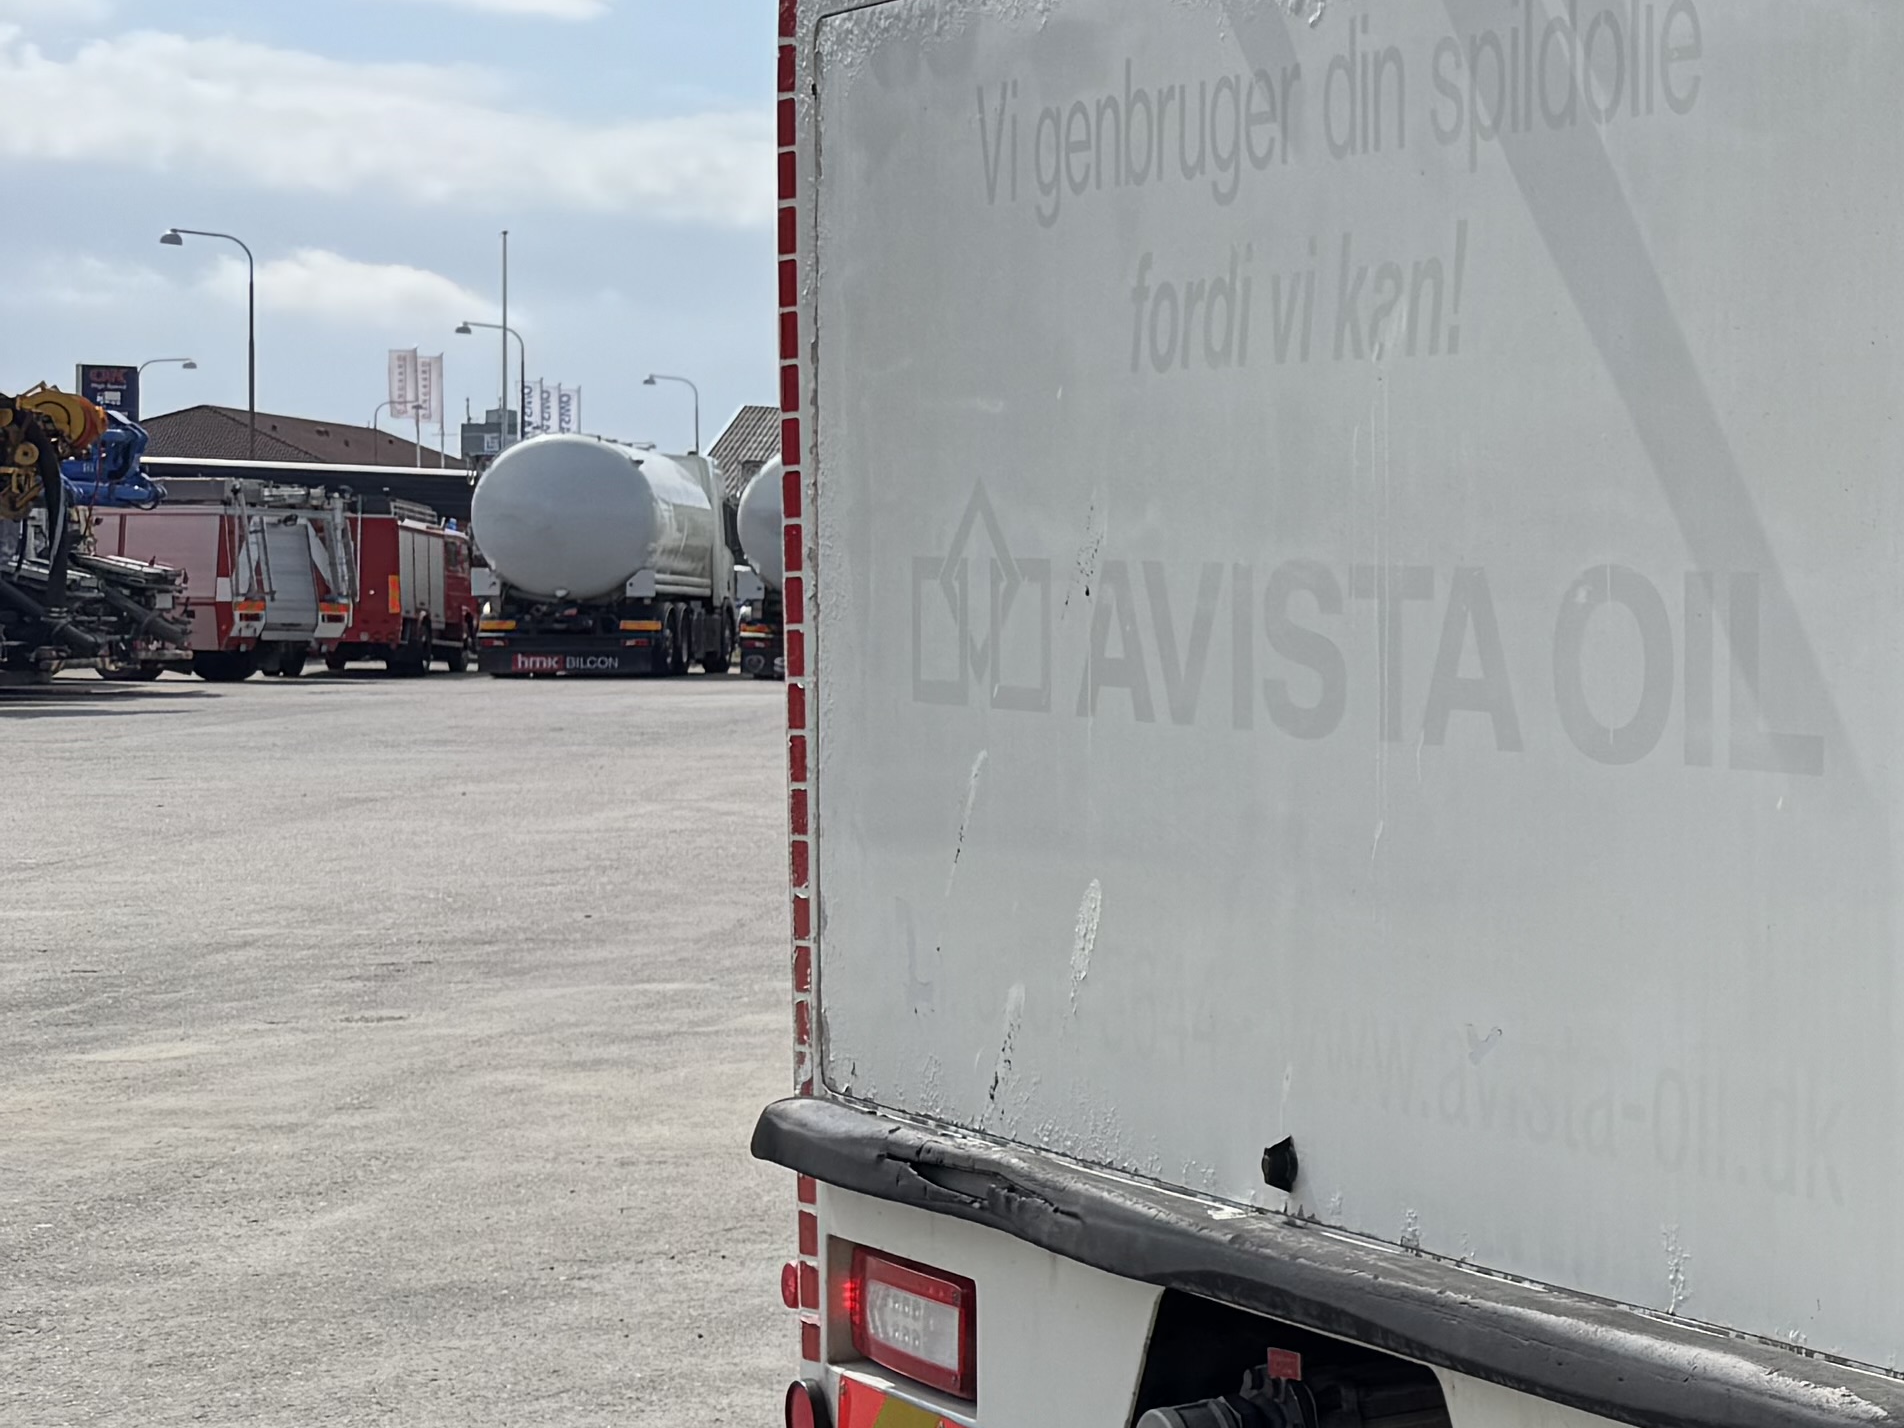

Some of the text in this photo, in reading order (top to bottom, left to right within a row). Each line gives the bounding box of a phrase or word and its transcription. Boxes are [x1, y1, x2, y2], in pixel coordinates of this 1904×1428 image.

[975, 77, 1018, 207] Vi
[1034, 57, 1304, 229] genbruger
[1322, 15, 1407, 165] din
[1129, 243, 1252, 374] fordi
[1270, 233, 1316, 362] vi
[565, 656, 619, 669] BILCON
[1076, 558, 1826, 777] AVISTA OIL
